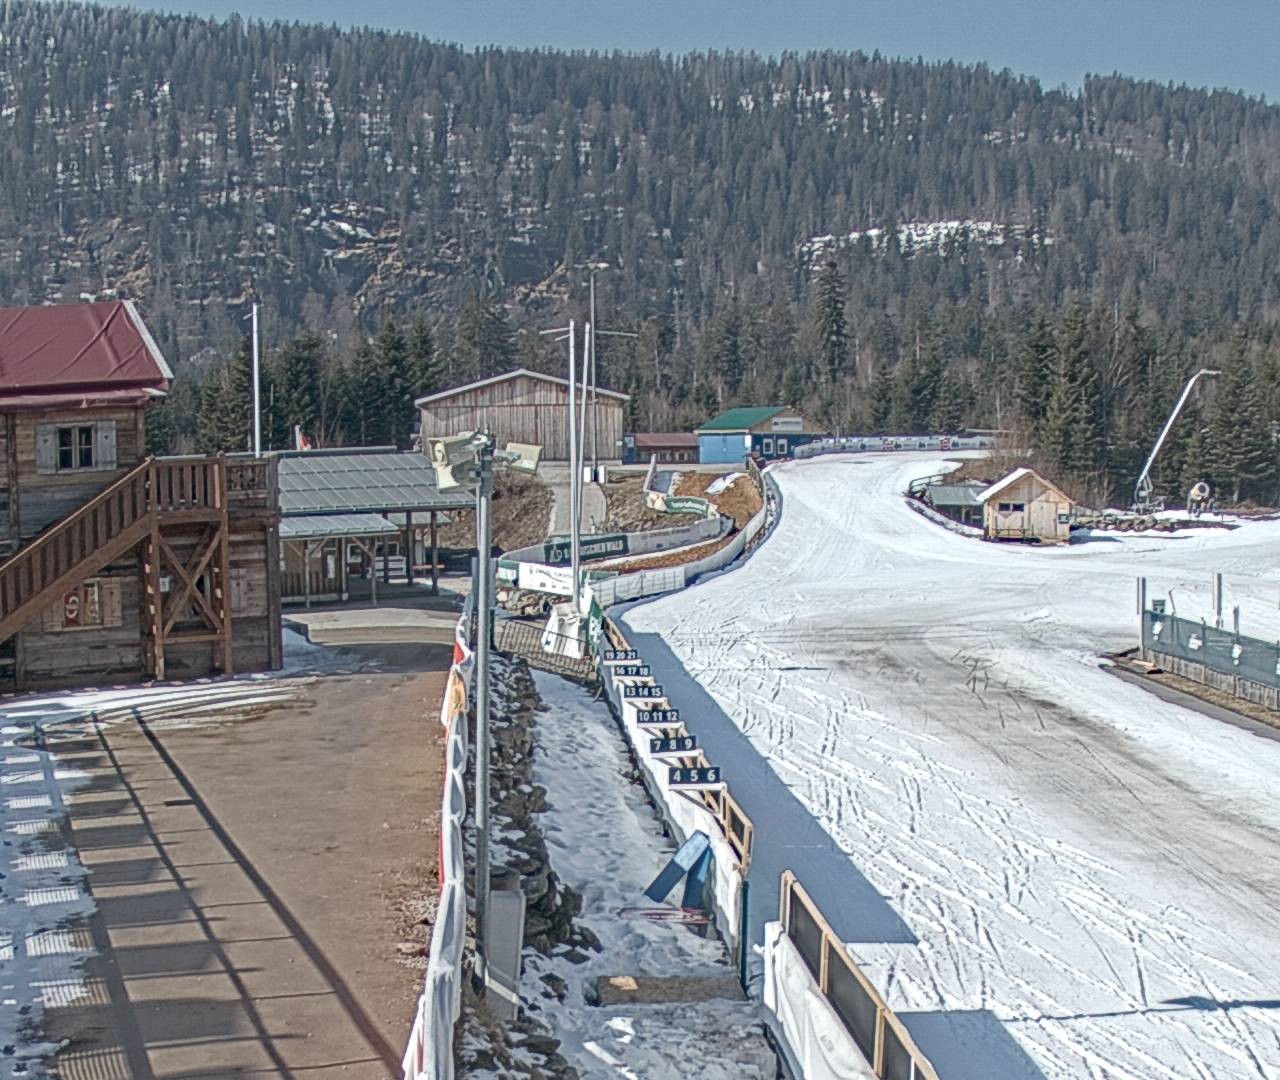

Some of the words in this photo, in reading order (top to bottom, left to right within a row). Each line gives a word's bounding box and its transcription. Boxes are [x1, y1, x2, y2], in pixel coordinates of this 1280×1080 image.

[627, 667, 637, 675] 17
[626, 688, 635, 696] 13
[638, 688, 649, 696] 14
[651, 687, 661, 696] 15
[638, 712, 650, 721] 10
[652, 712, 663, 721] 11
[666, 712, 678, 721] 12
[654, 741, 662, 751] 7
[669, 740, 677, 750] 8
[685, 739, 692, 749] 9
[673, 770, 681, 782] 4
[690, 770, 698, 782] 5
[707, 770, 716, 781] 6
